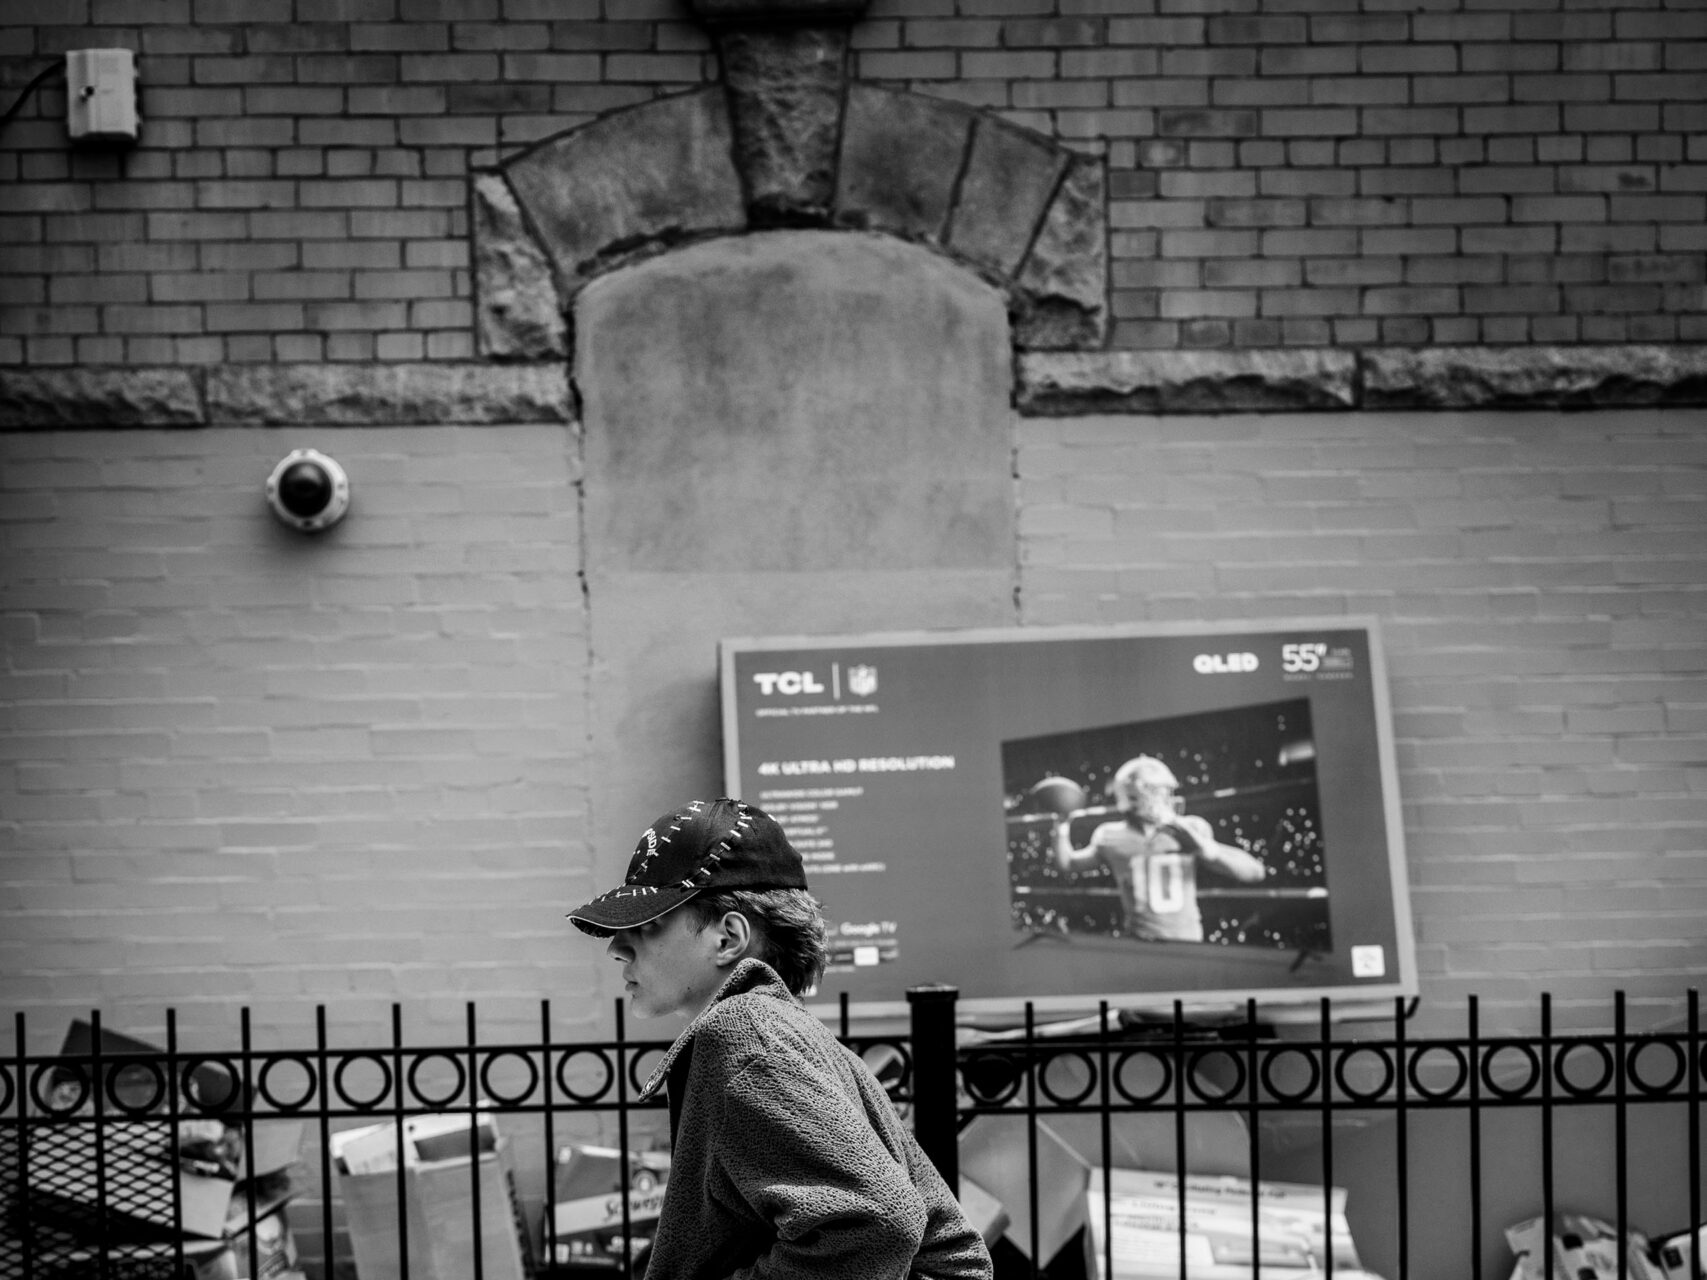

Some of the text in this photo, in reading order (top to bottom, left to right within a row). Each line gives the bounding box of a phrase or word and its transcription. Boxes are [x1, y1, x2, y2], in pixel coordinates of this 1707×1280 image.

[753, 671, 825, 695] TCL
[781, 759, 832, 775] ULTRA
[833, 758, 857, 774] HD
[858, 755, 956, 773] RESOLUTION
